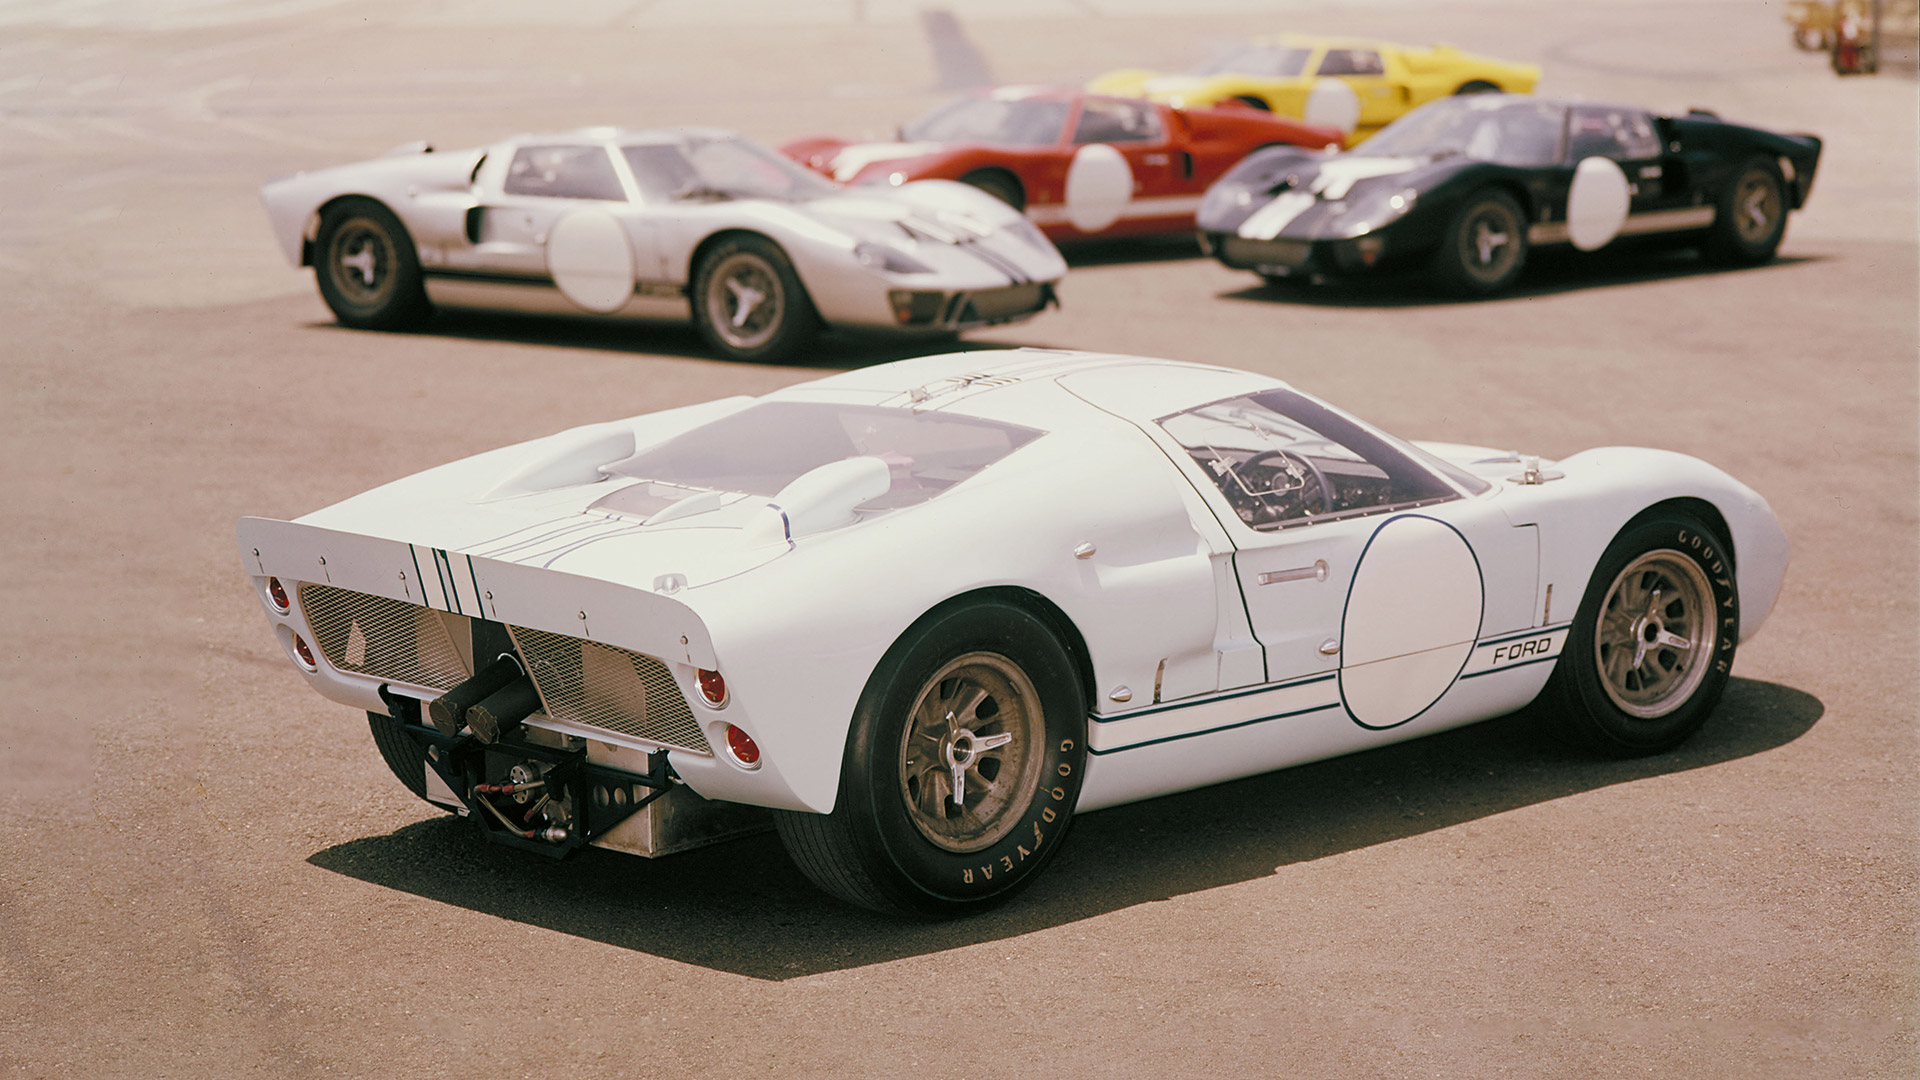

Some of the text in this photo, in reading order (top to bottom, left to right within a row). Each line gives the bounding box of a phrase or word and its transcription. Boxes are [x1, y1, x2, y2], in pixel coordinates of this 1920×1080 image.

[1493, 638, 1552, 665] FORD
[1678, 530, 1735, 673] GOODYEAR
[963, 738, 1074, 885] GOODYEAR
